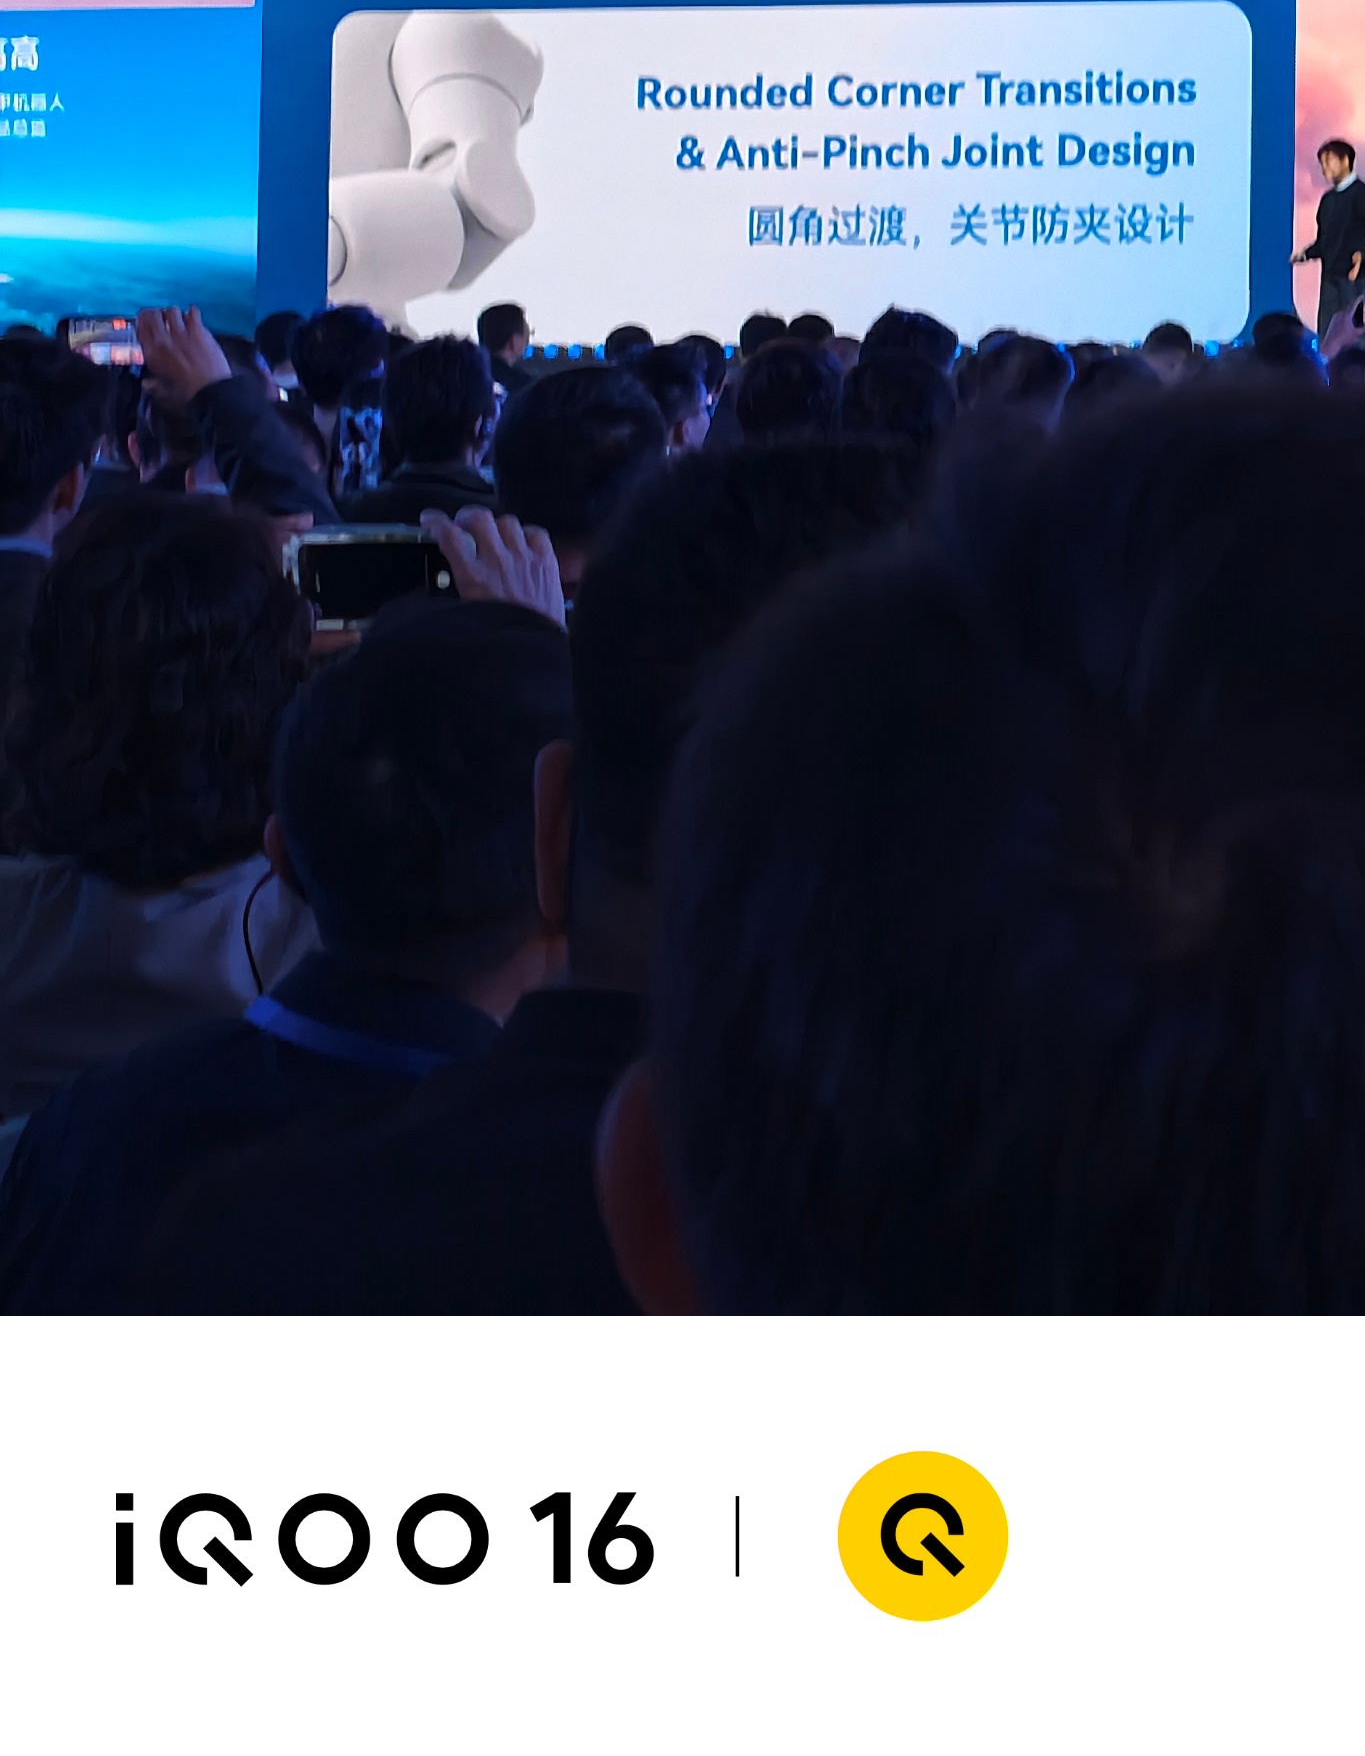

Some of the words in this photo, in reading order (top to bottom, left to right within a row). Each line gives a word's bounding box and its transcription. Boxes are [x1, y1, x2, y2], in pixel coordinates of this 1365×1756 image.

[0, 35, 40, 72] 高
[636, 72, 813, 111] Rounded
[827, 73, 966, 109] Corner
[975, 68, 1197, 108] Transitions
[675, 135, 706, 171] &
[716, 132, 930, 171] Anti-Pinch
[940, 131, 1045, 170] Joint
[1057, 130, 1195, 178] Design
